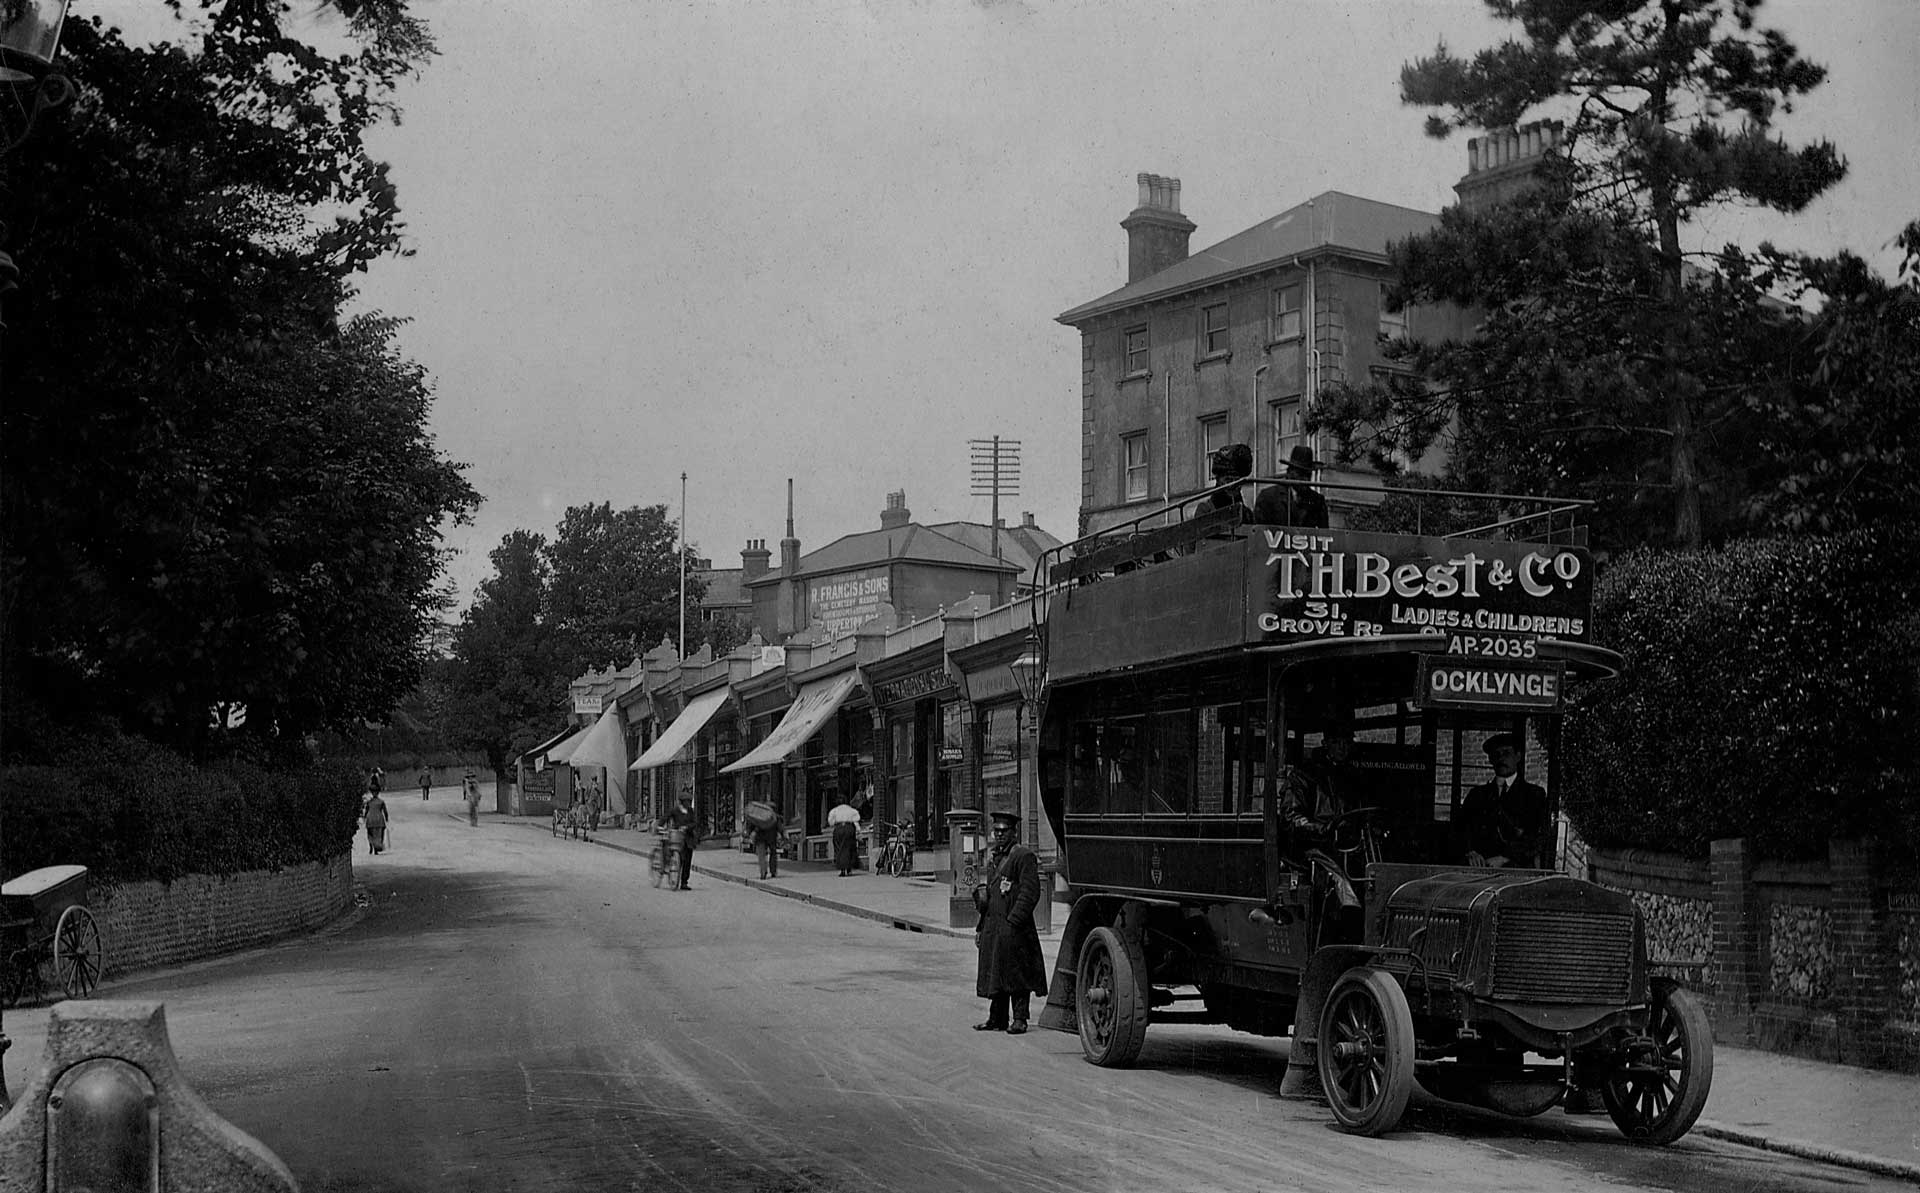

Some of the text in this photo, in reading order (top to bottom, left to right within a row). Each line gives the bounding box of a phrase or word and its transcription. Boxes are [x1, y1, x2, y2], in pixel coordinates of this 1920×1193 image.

[1264, 529, 1334, 552] VISIT
[820, 581, 858, 602] FRANCIS
[864, 576, 889, 594] SONS
[1257, 612, 1345, 636] GROVE
[1391, 603, 1460, 628] LADIES
[1475, 608, 1584, 635] CHILDRENS
[1431, 670, 1557, 697] OCKLYNGE
